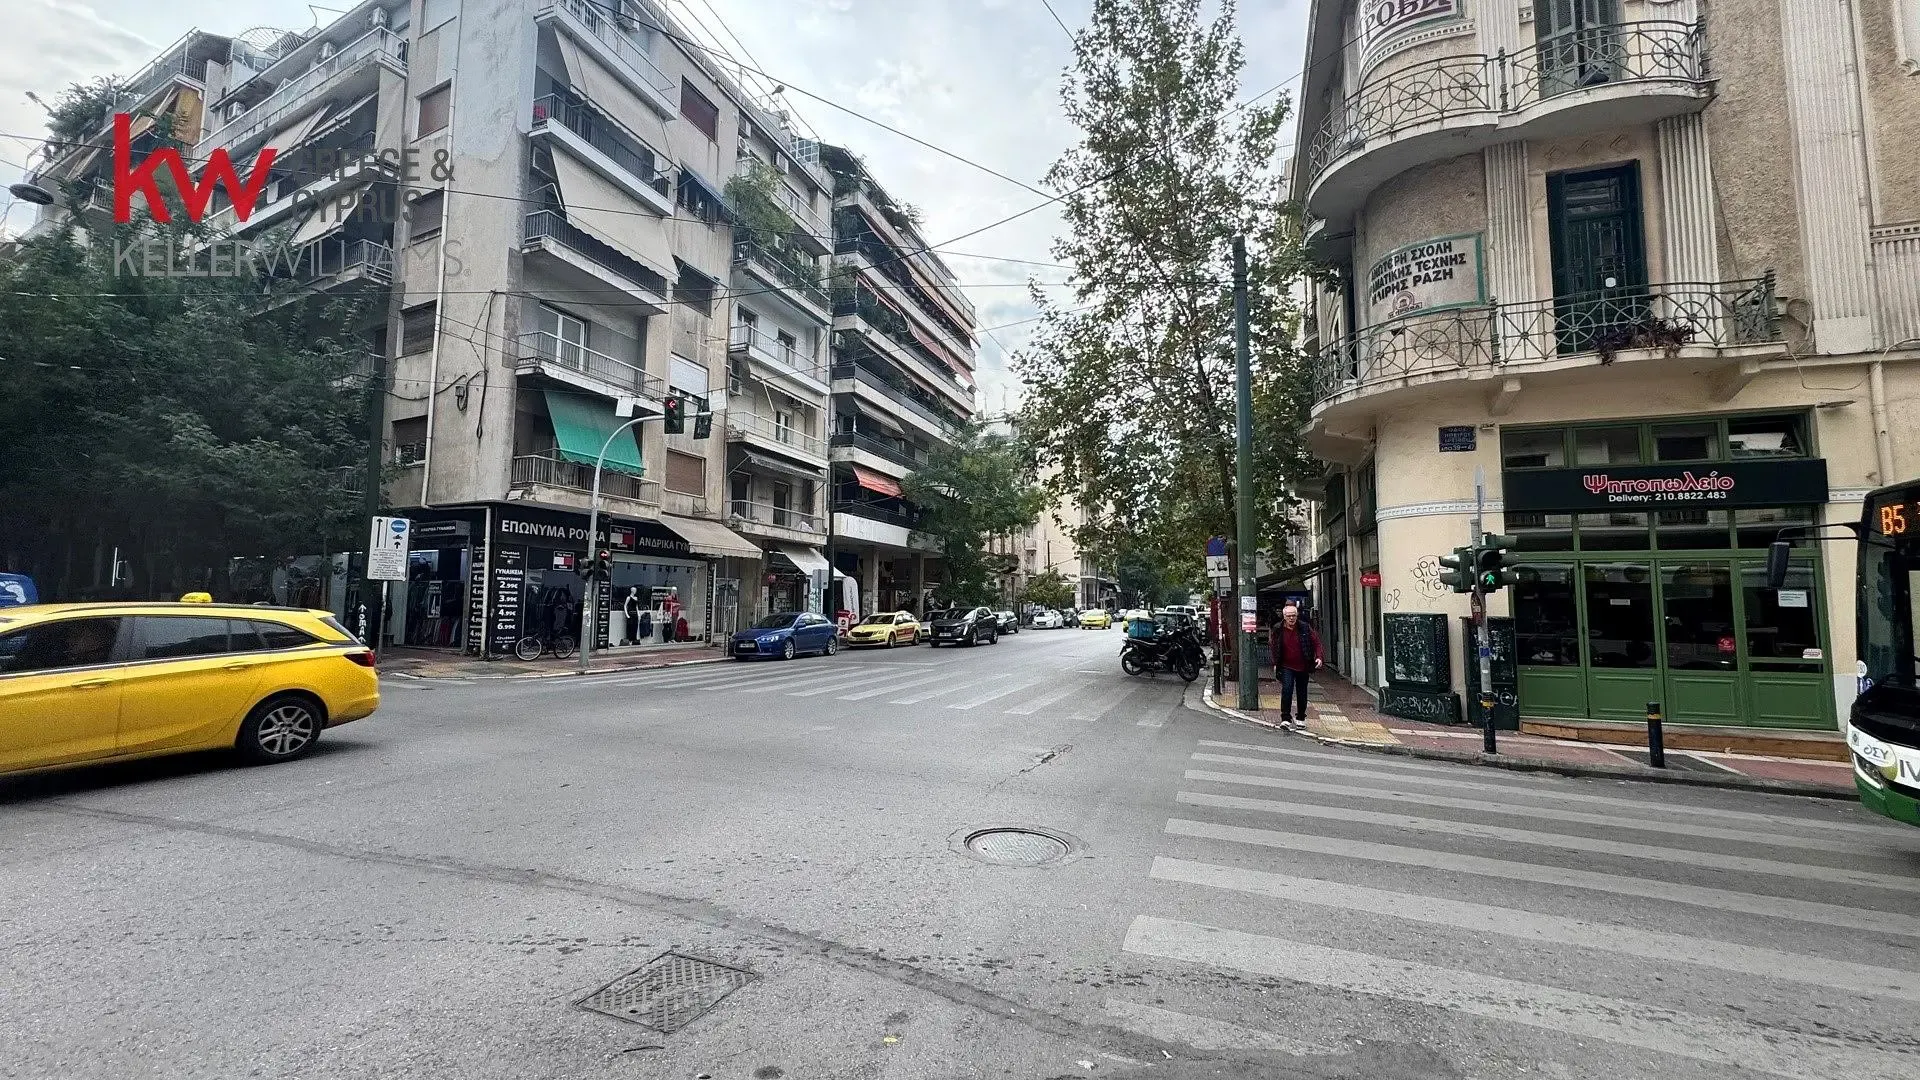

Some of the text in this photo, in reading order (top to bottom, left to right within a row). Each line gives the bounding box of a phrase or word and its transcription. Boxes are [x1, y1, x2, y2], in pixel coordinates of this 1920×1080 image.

[1410, 241, 1452, 261] ΣΧΟΛΗ
[1415, 253, 1467, 272] ΤΕΧΝΗΣ
[1413, 267, 1454, 287] ΡΑΖΗ
[1583, 471, 1735, 494] Ψητοπωλείο
[1608, 491, 1727, 503] Delivery: 210.8822.483
[502, 519, 566, 538] ΕΠΩΝΥΜΑ
[639, 536, 675, 550] ΑΝΔΡΙΚΑ
